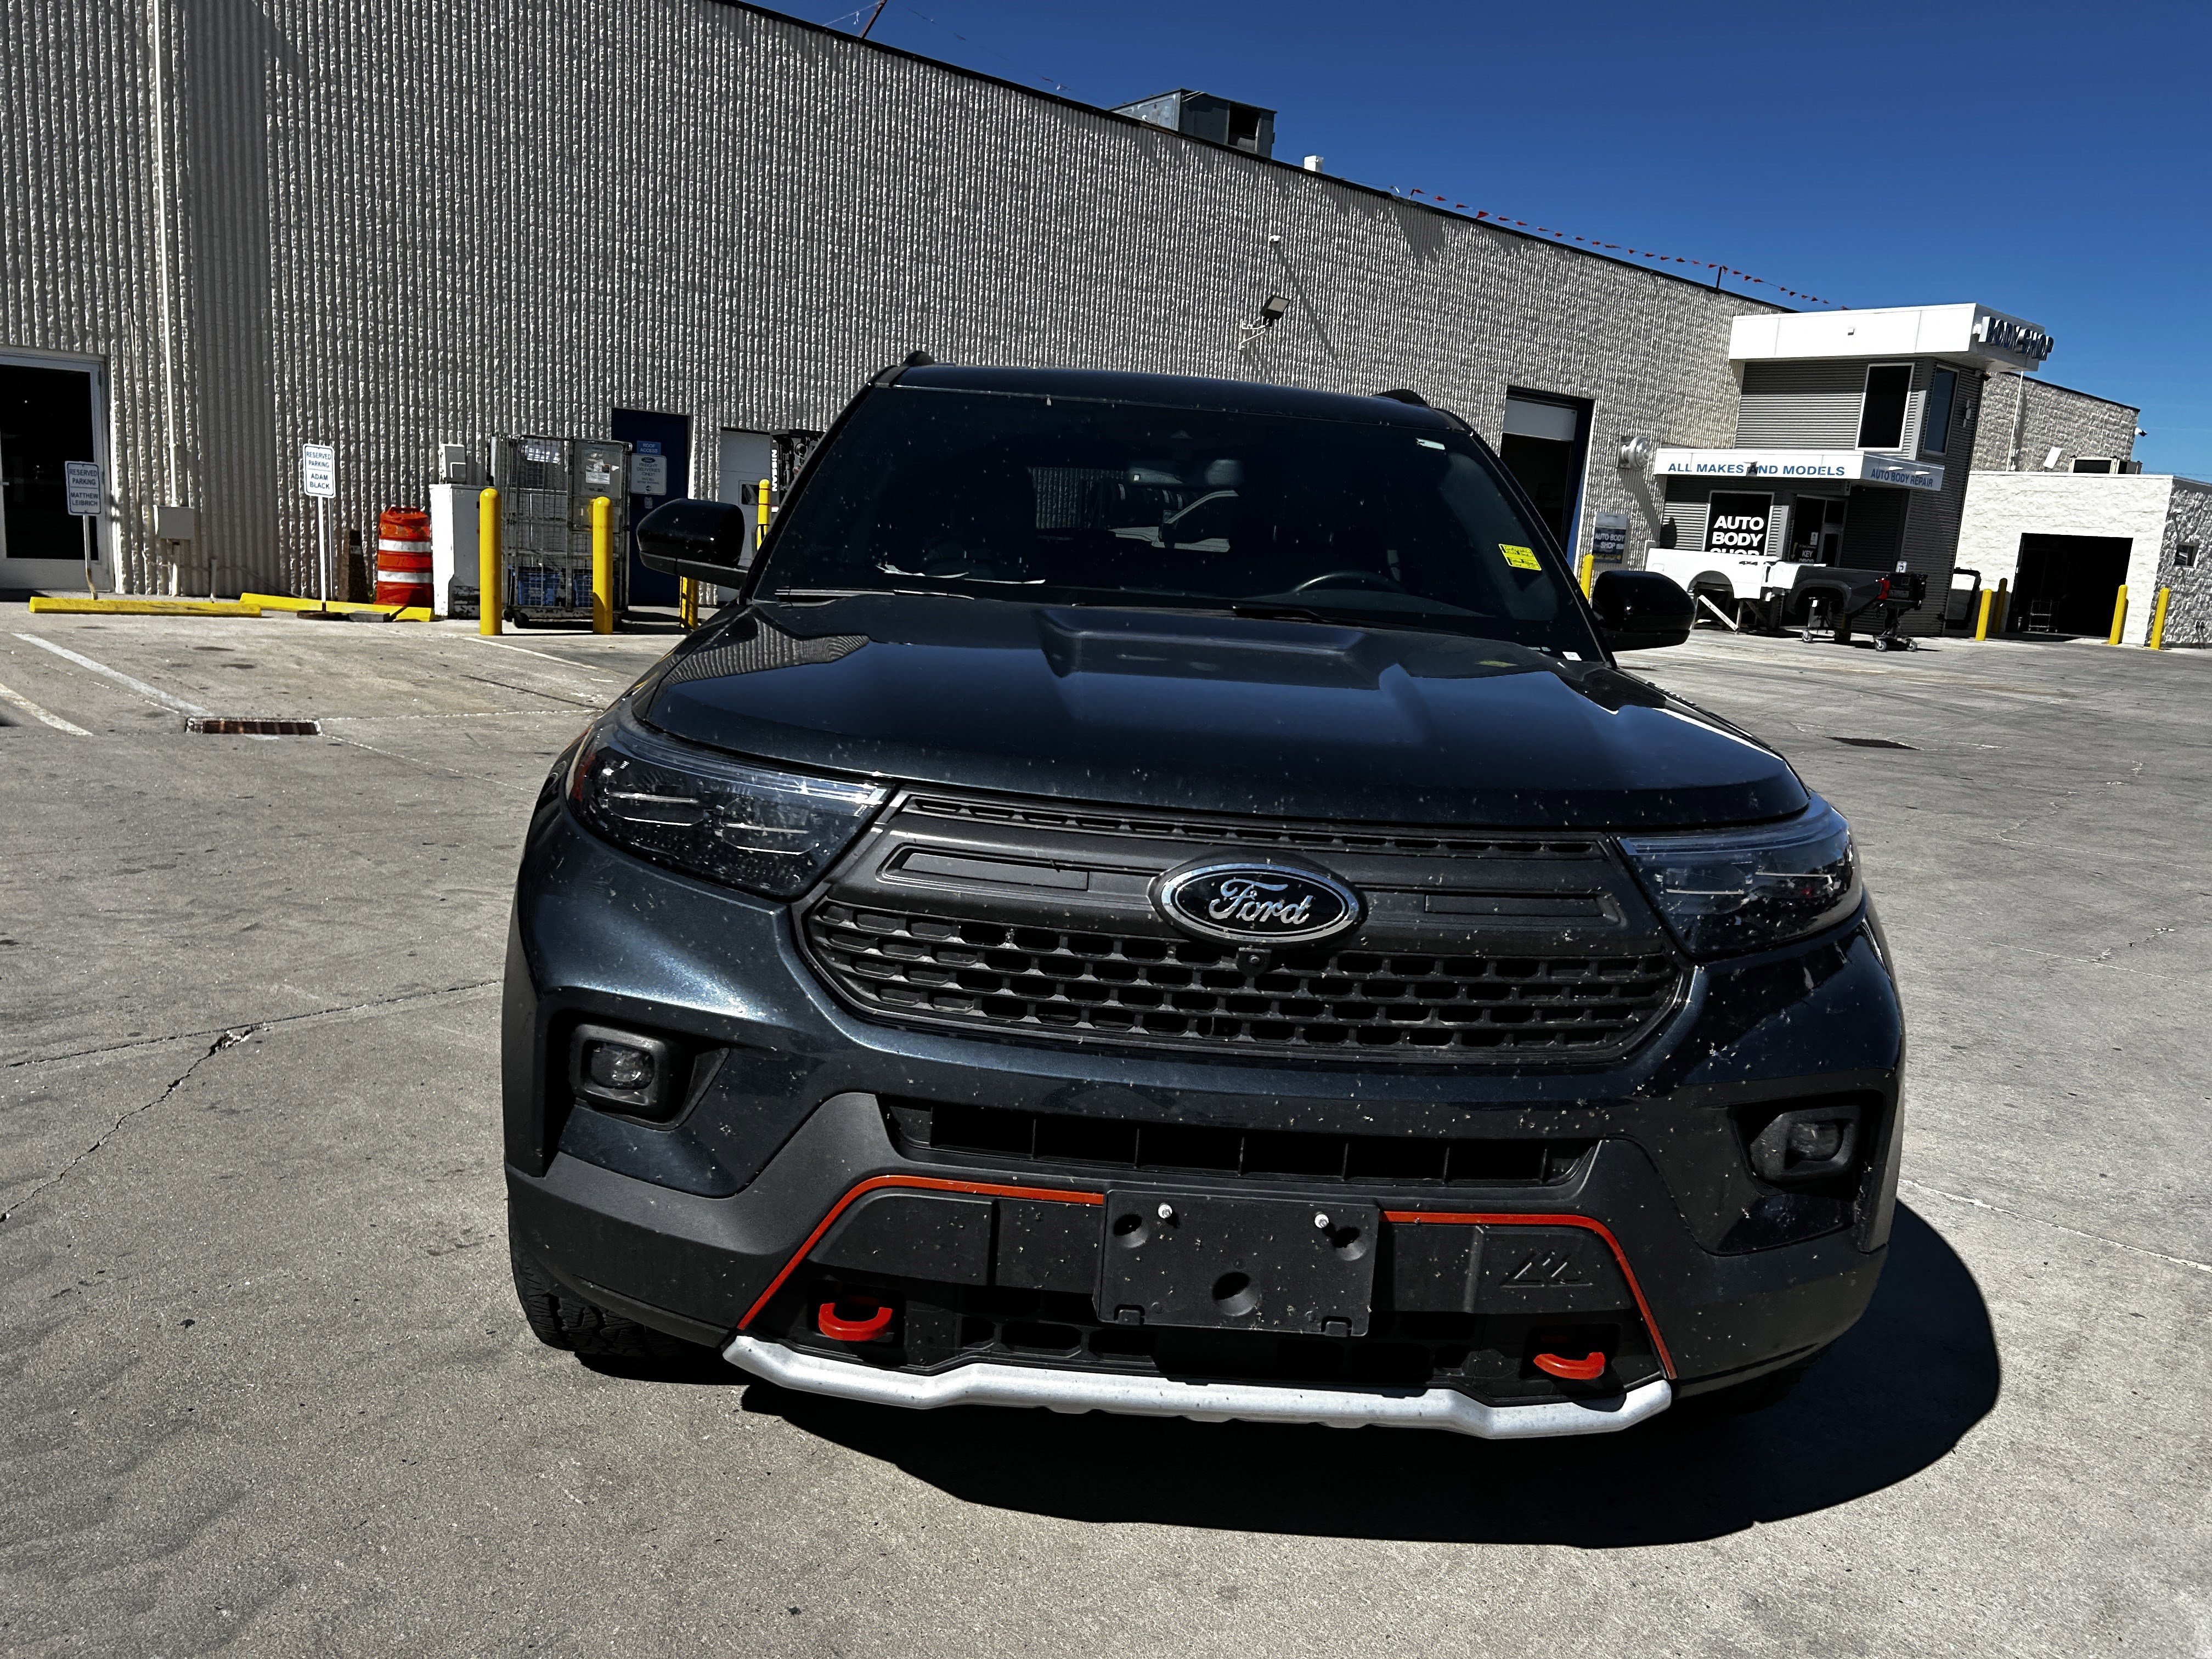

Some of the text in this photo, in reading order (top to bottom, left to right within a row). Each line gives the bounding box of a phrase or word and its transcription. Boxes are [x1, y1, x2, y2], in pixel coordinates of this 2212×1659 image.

[1979, 317, 2021, 351] BODY
[307, 452, 331, 460] RESERVED
[69, 469, 97, 477] RESERVED
[1668, 463, 1845, 476] ALL MAKES AND MODELS
[309, 481, 330, 489] BLACK
[1871, 469, 1933, 488] AUTO BODY REPAIR
[1714, 516, 1764, 531] AUTO
[1712, 532, 1764, 546] BODY
[1209, 879, 1314, 925] Ford
